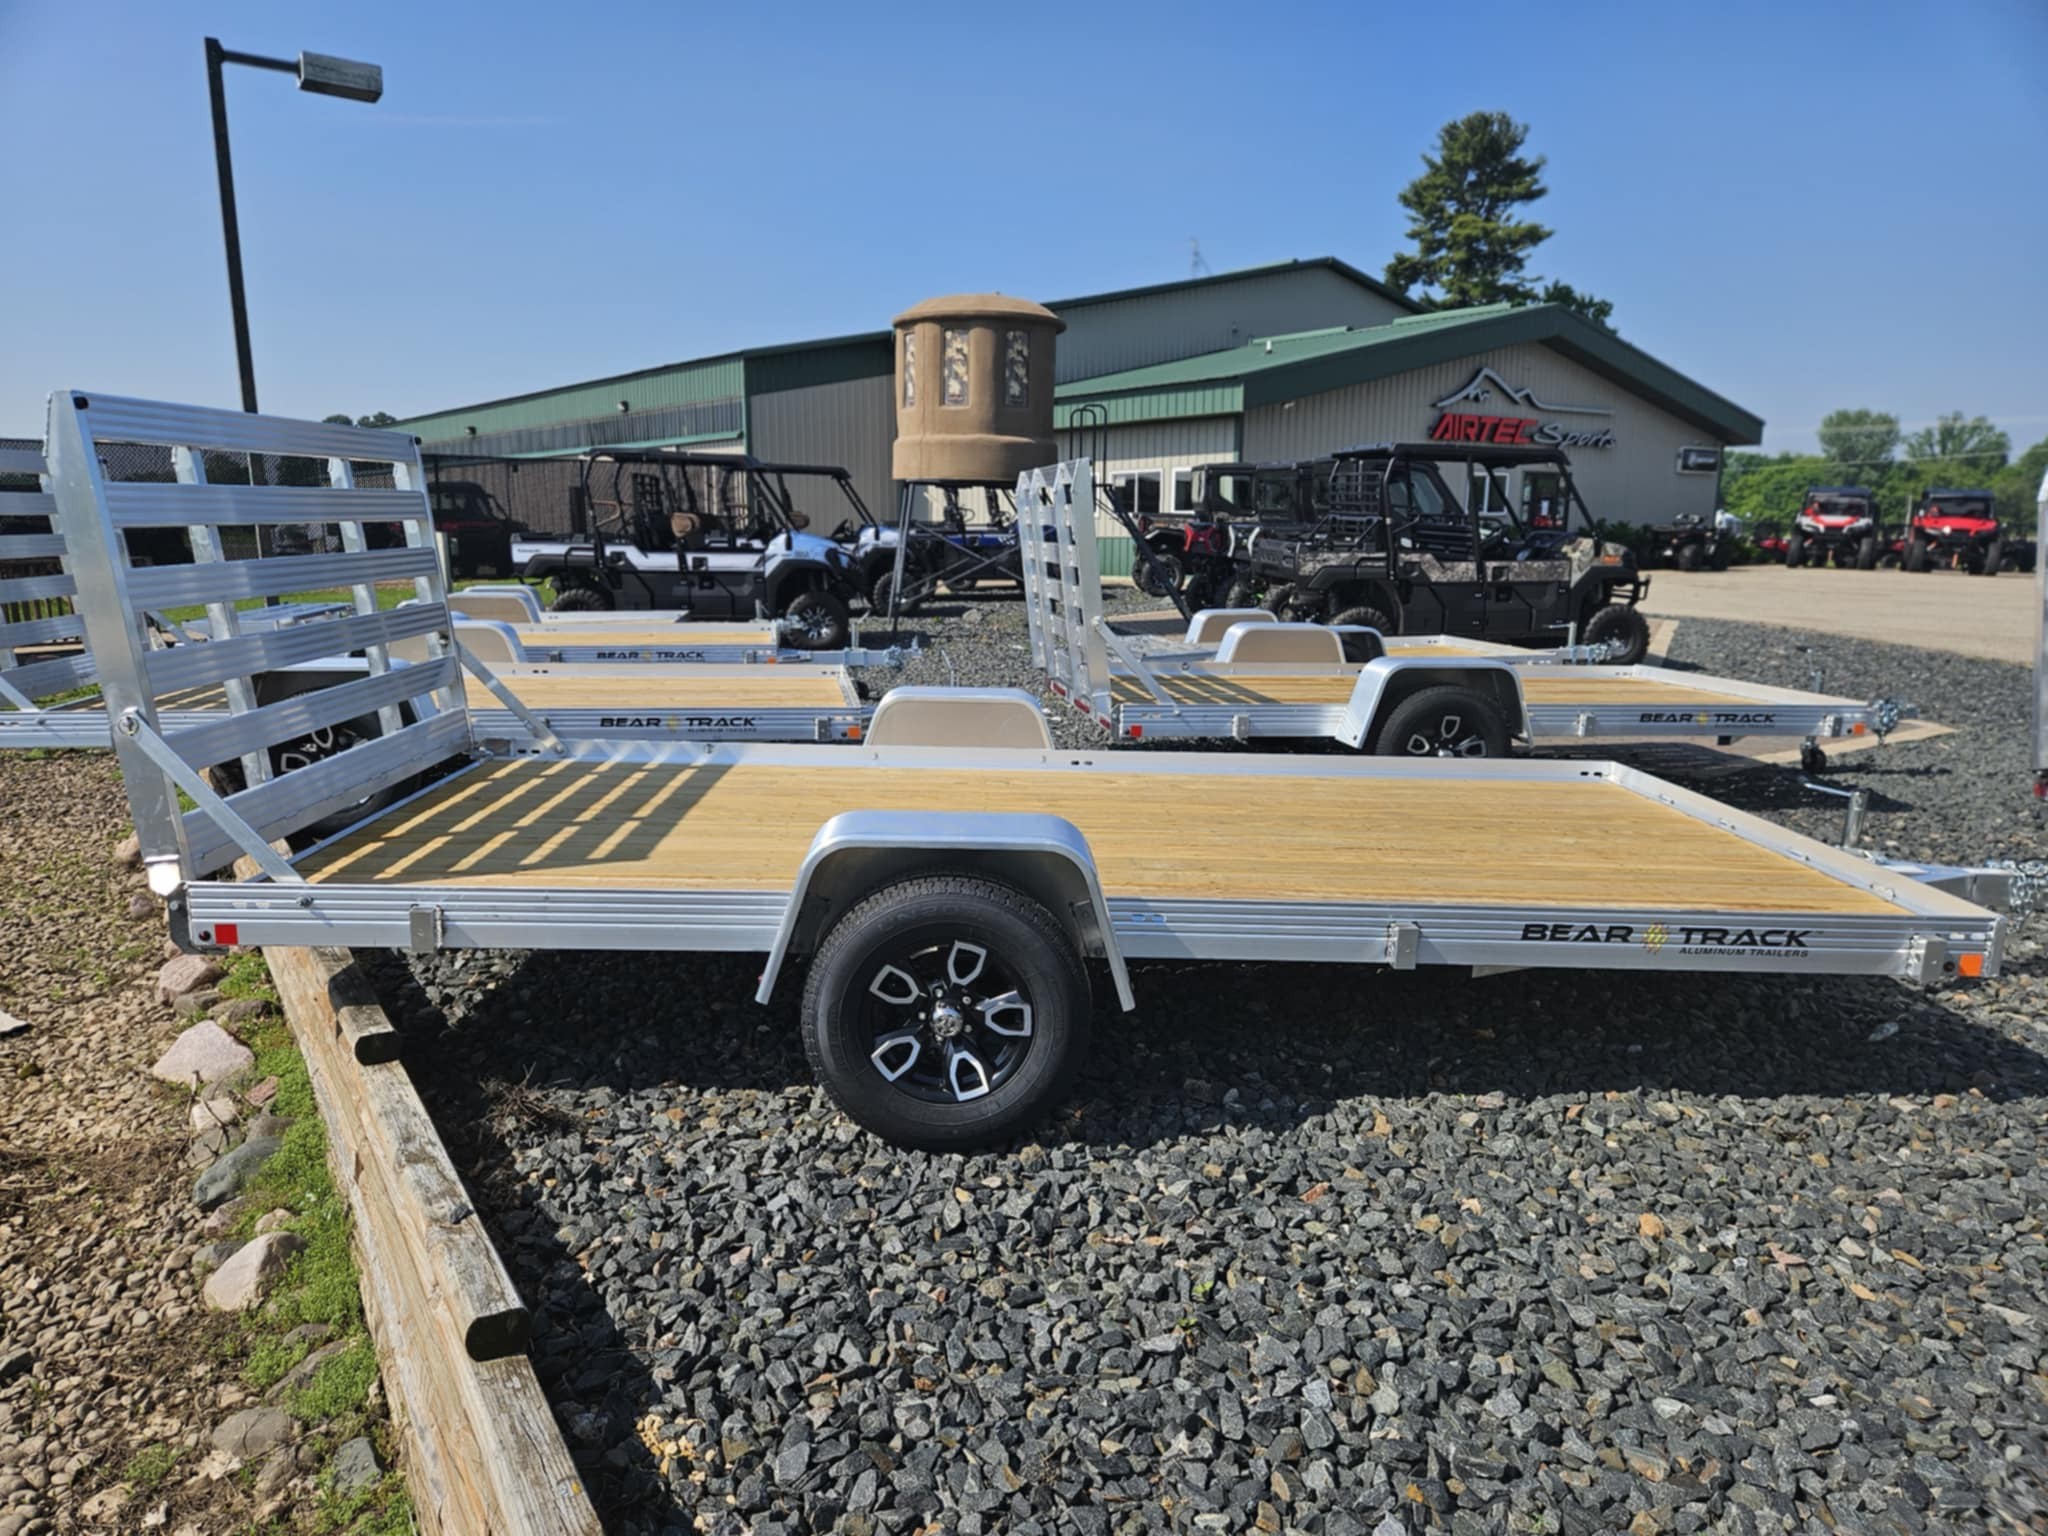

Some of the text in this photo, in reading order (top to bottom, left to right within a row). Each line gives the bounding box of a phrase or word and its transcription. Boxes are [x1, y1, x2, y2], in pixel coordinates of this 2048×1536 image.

[1432, 413, 1615, 450] AIRTEC Sports
[596, 651, 705, 659] BEAR TRACK
[600, 717, 756, 727] BEAR TRACK
[1639, 713, 1776, 723] BEAR TRACK
[1520, 923, 1812, 947] BEAR TRACK
[1679, 947, 1809, 958] ALUMINUM TRAILERS
